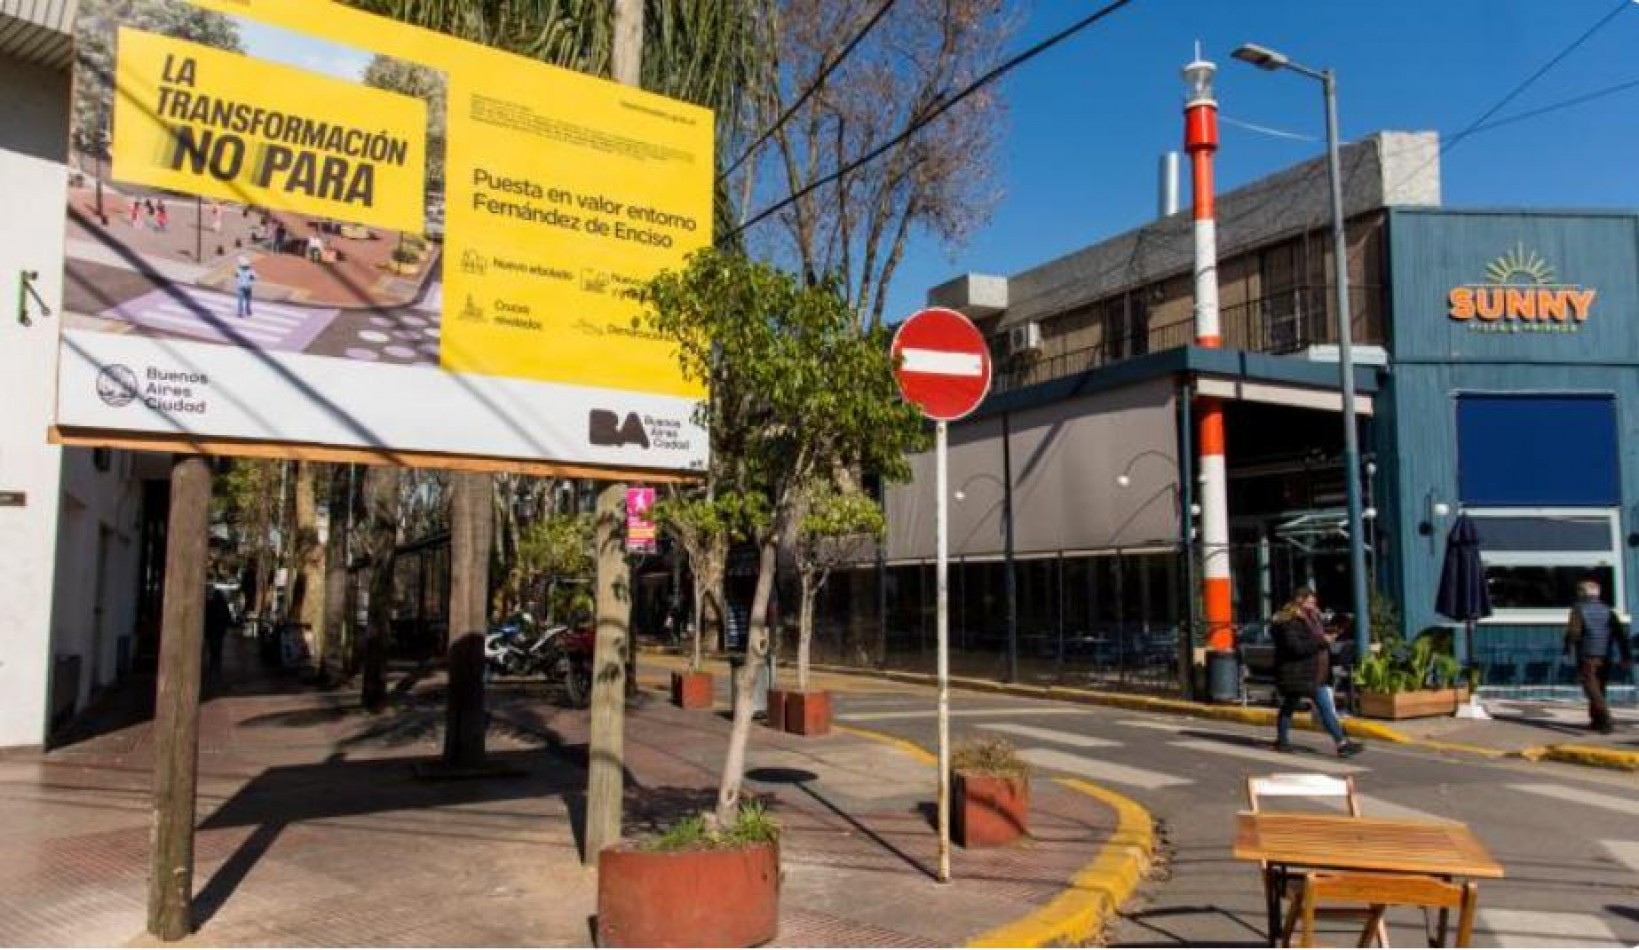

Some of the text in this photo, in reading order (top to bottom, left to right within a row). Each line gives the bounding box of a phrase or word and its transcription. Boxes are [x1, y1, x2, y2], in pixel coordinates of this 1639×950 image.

[162, 53, 197, 88] LA
[156, 85, 408, 167] TRANSFORMACIÓN
[171, 125, 375, 208] NO PARA
[473, 167, 698, 232] Puesta en valor entorno
[473, 192, 674, 249] Fernández de Enciso
[1448, 286, 1596, 323] SUNNY
[146, 381, 193, 398] Aires
[147, 366, 209, 384] Buenos
[145, 397, 207, 414] Ciudad
[589, 408, 650, 449] BA
